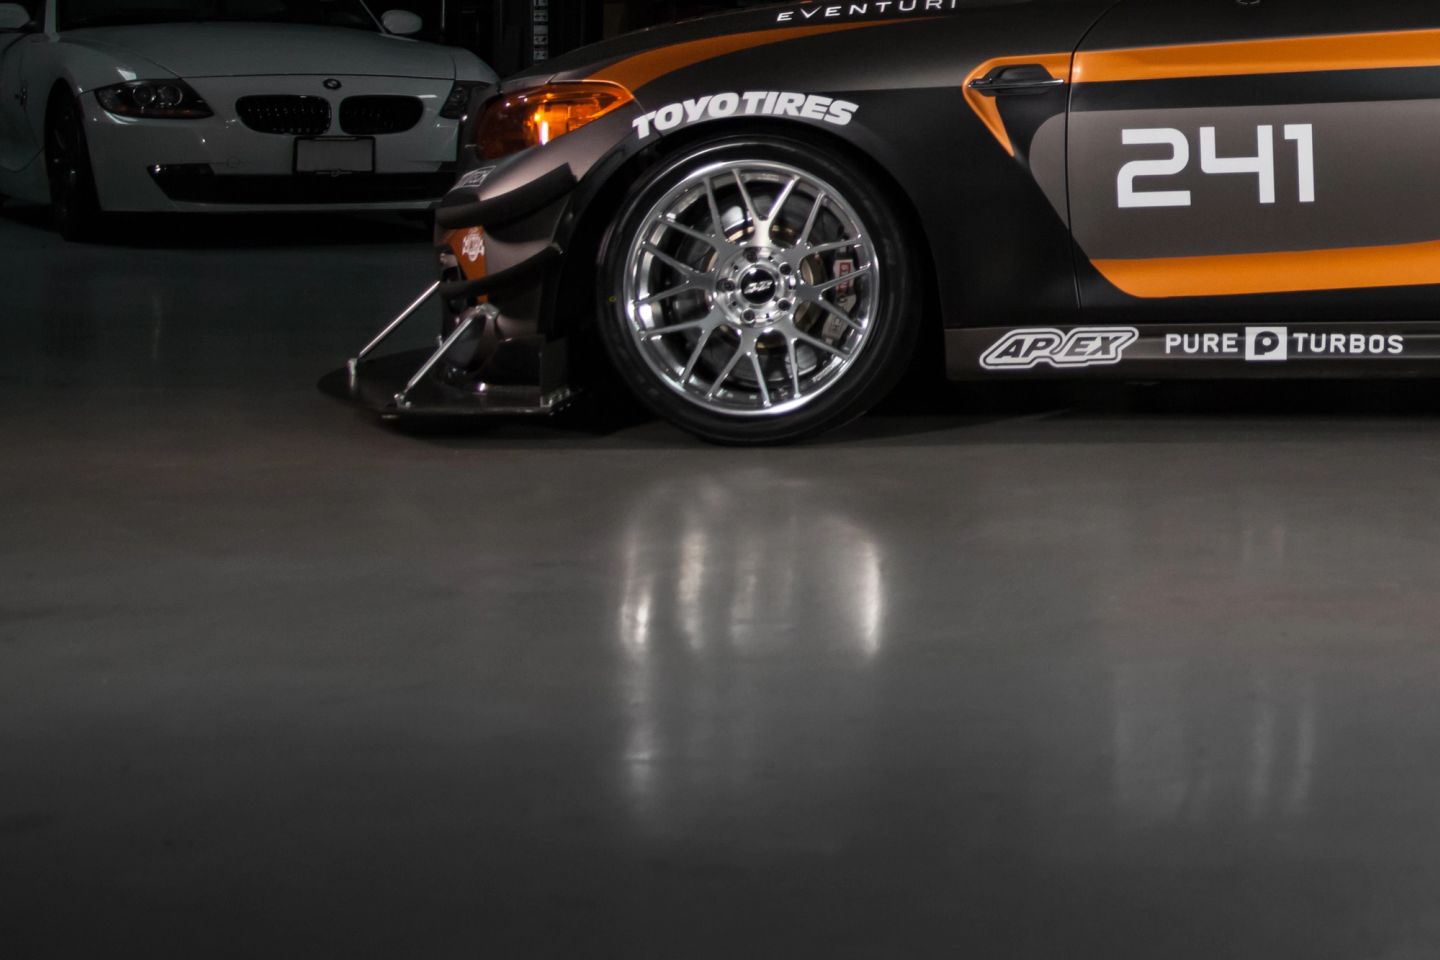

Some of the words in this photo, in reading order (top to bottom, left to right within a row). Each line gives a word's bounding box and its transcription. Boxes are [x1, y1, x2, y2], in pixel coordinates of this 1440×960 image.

[1117, 123, 1315, 208] 241
[988, 328, 1137, 366] APEX
[1165, 333, 1239, 355] PURE
[1293, 332, 1403, 355] TURBOS
